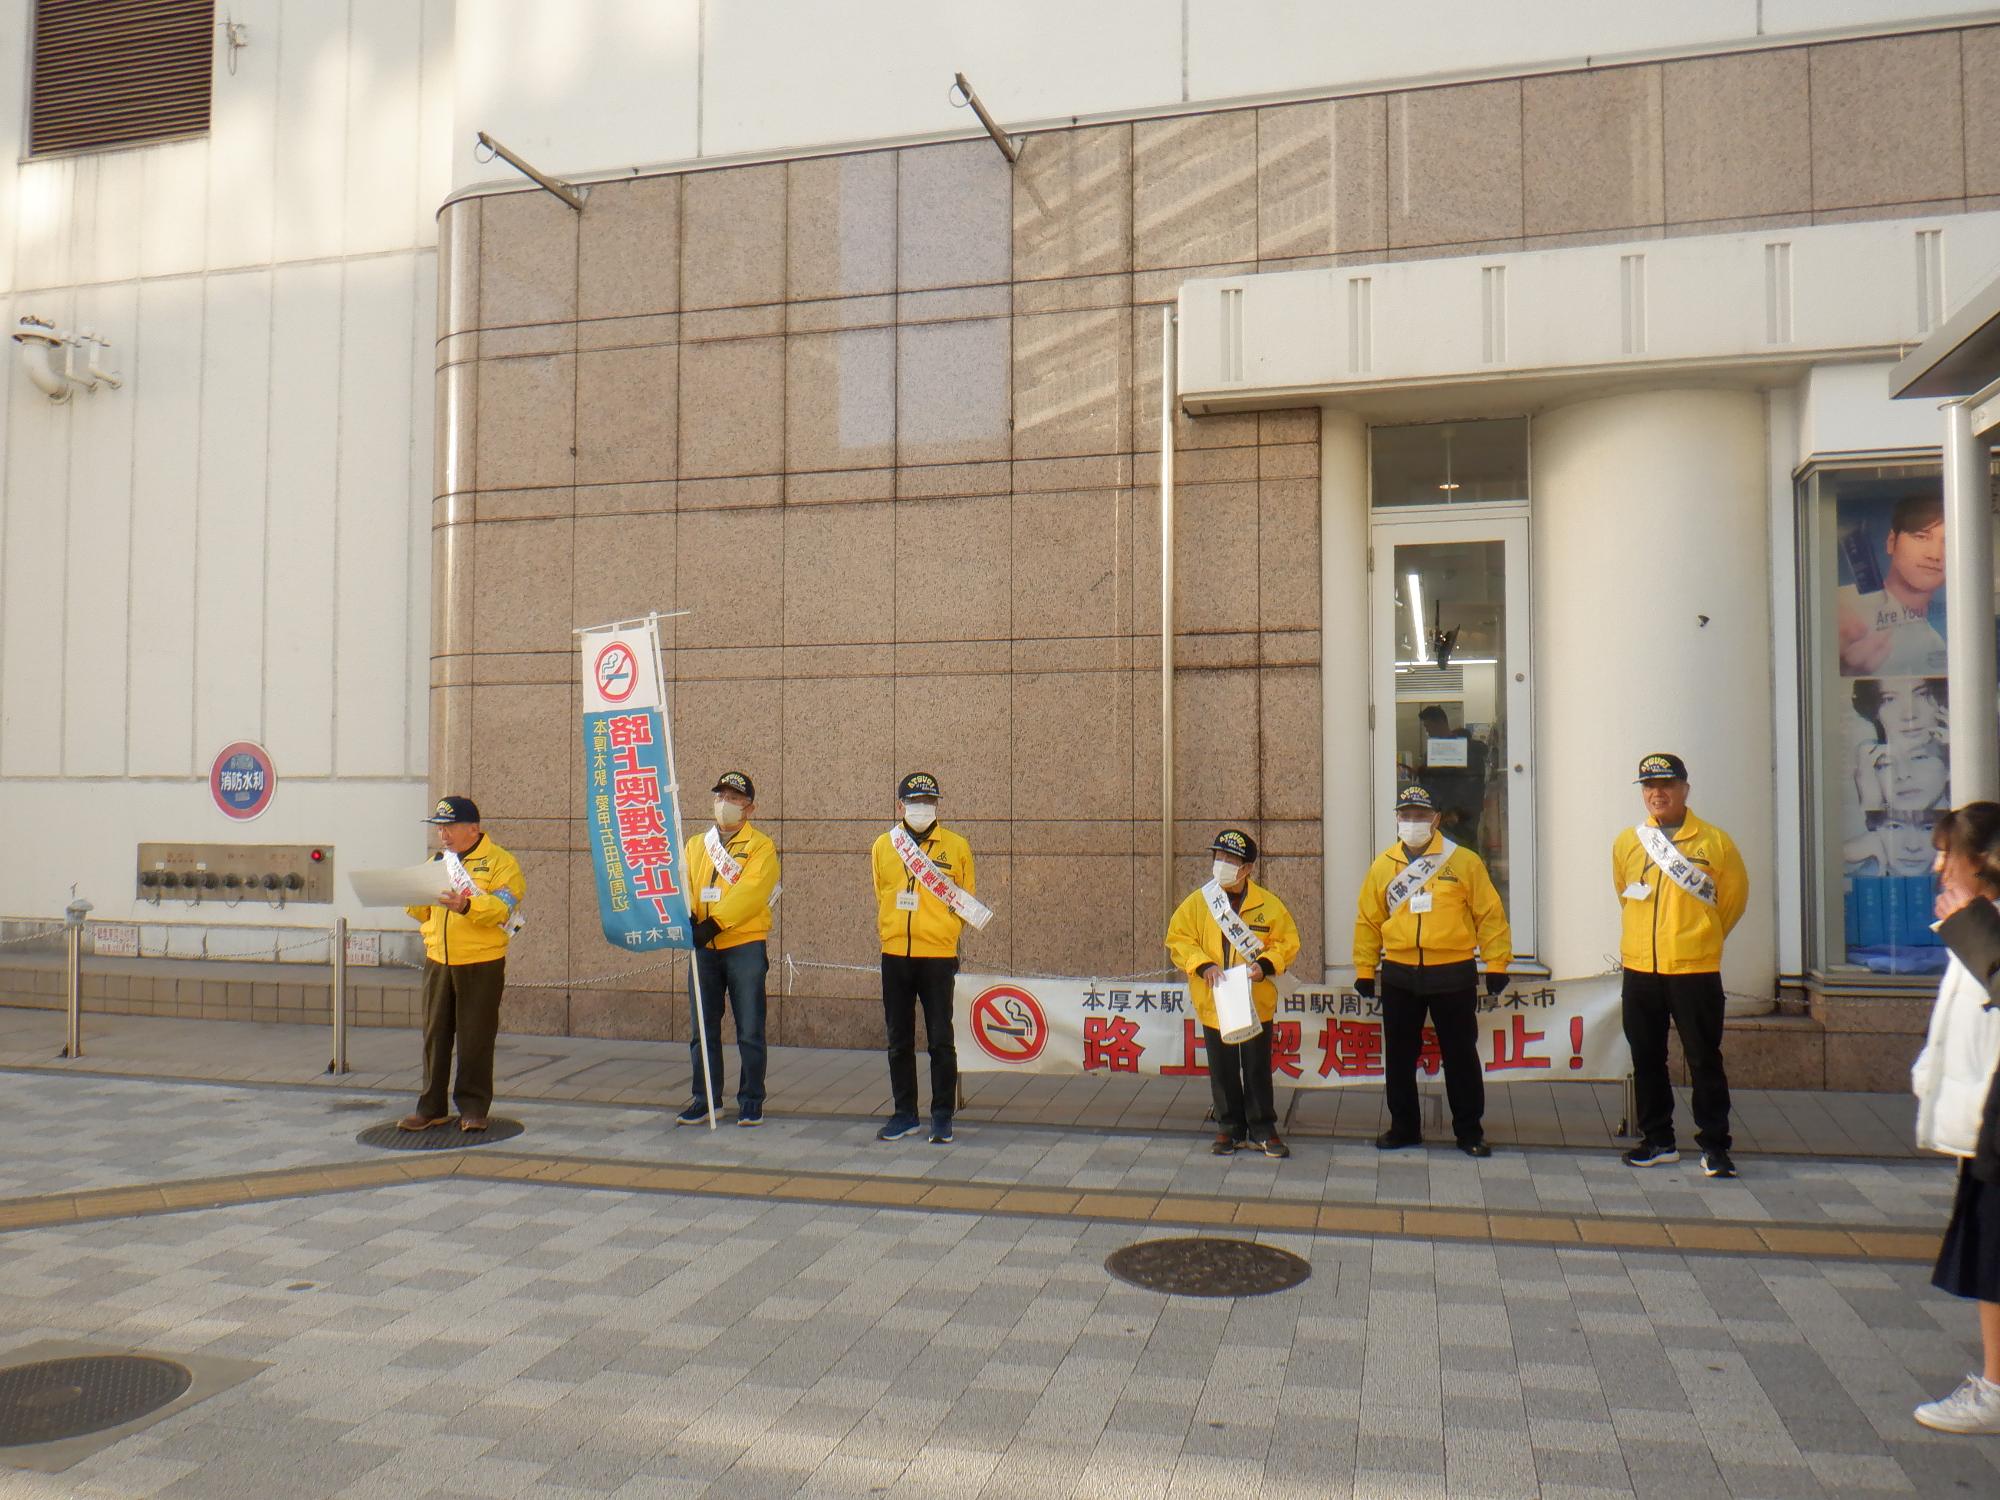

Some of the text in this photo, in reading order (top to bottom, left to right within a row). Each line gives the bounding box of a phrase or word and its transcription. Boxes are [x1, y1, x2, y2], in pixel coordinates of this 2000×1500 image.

[1876, 610, 1897, 625] Are
[1902, 605, 1923, 619] You
[220, 771, 264, 791] 消防水利
